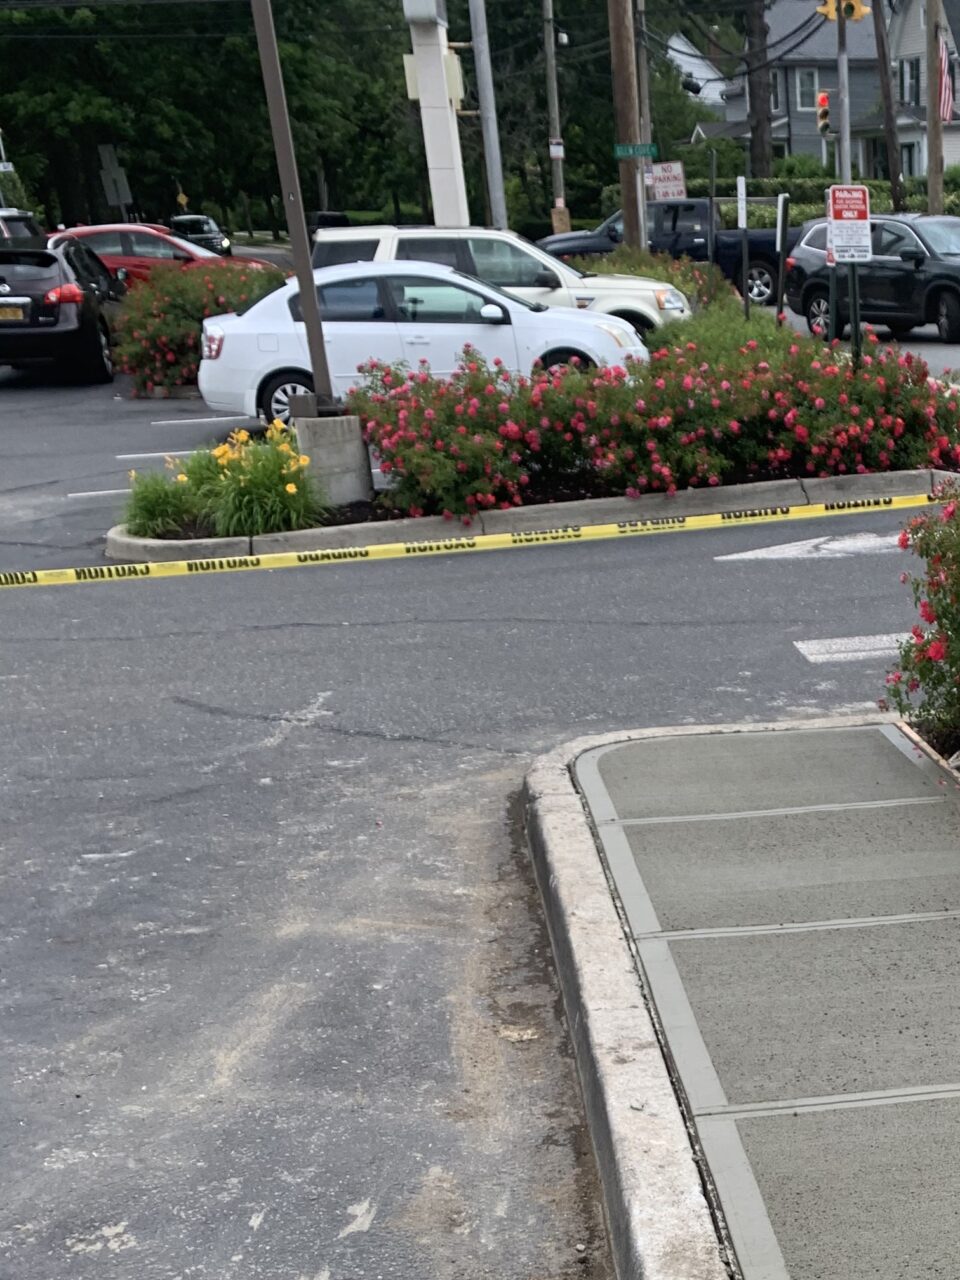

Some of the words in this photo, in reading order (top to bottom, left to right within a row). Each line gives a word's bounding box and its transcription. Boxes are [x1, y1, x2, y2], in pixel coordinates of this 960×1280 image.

[661, 164, 672, 173] NO
[653, 174, 682, 183] PARKING
[835, 190, 864, 199] PARKING
[841, 210, 858, 218] ONLY
